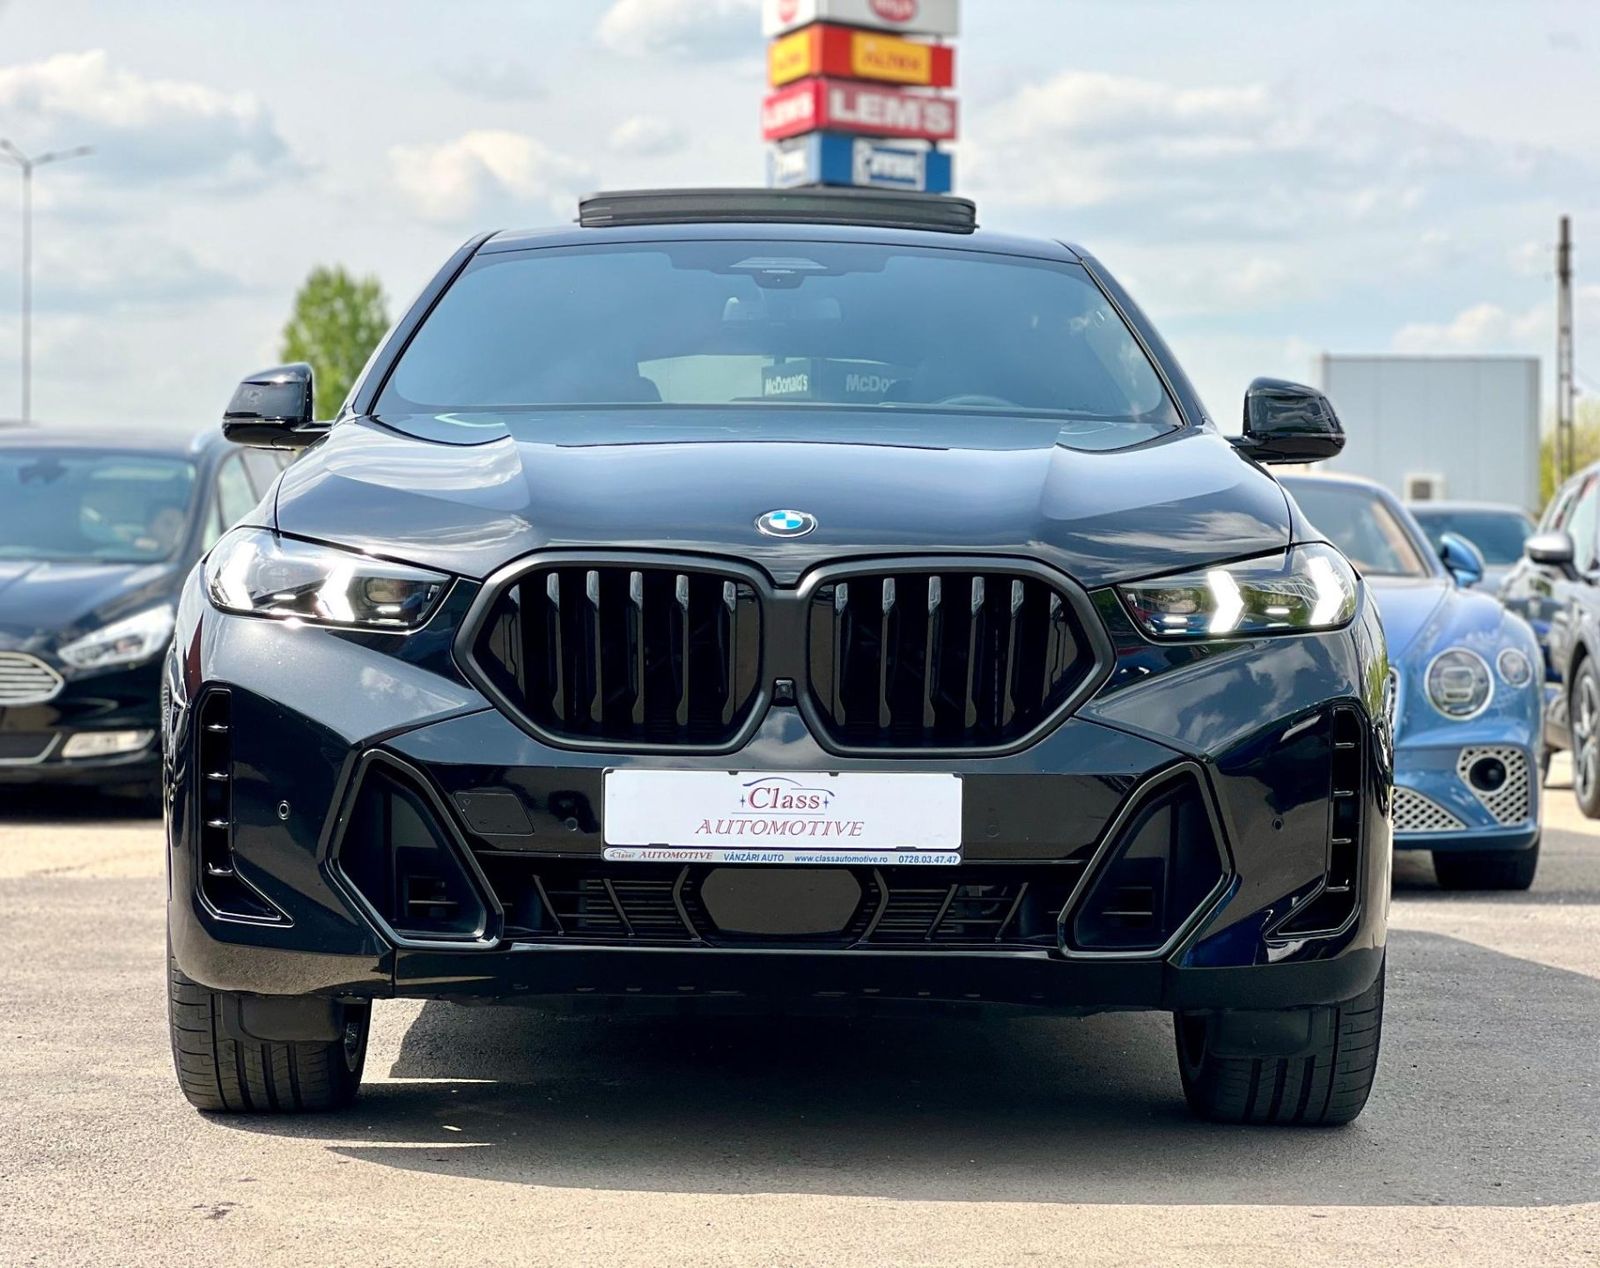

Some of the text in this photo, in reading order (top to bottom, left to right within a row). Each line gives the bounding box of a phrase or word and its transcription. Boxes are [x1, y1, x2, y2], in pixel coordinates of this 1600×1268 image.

[749, 786, 820, 809] Class
[694, 819, 865, 837] AUTOMOTIVE
[640, 851, 714, 860] AUTOMOTIVE
[761, 854, 785, 862] AUTO
[794, 854, 888, 864] www.classautomotive.ro
[898, 855, 957, 864] 0728.03.47.47
